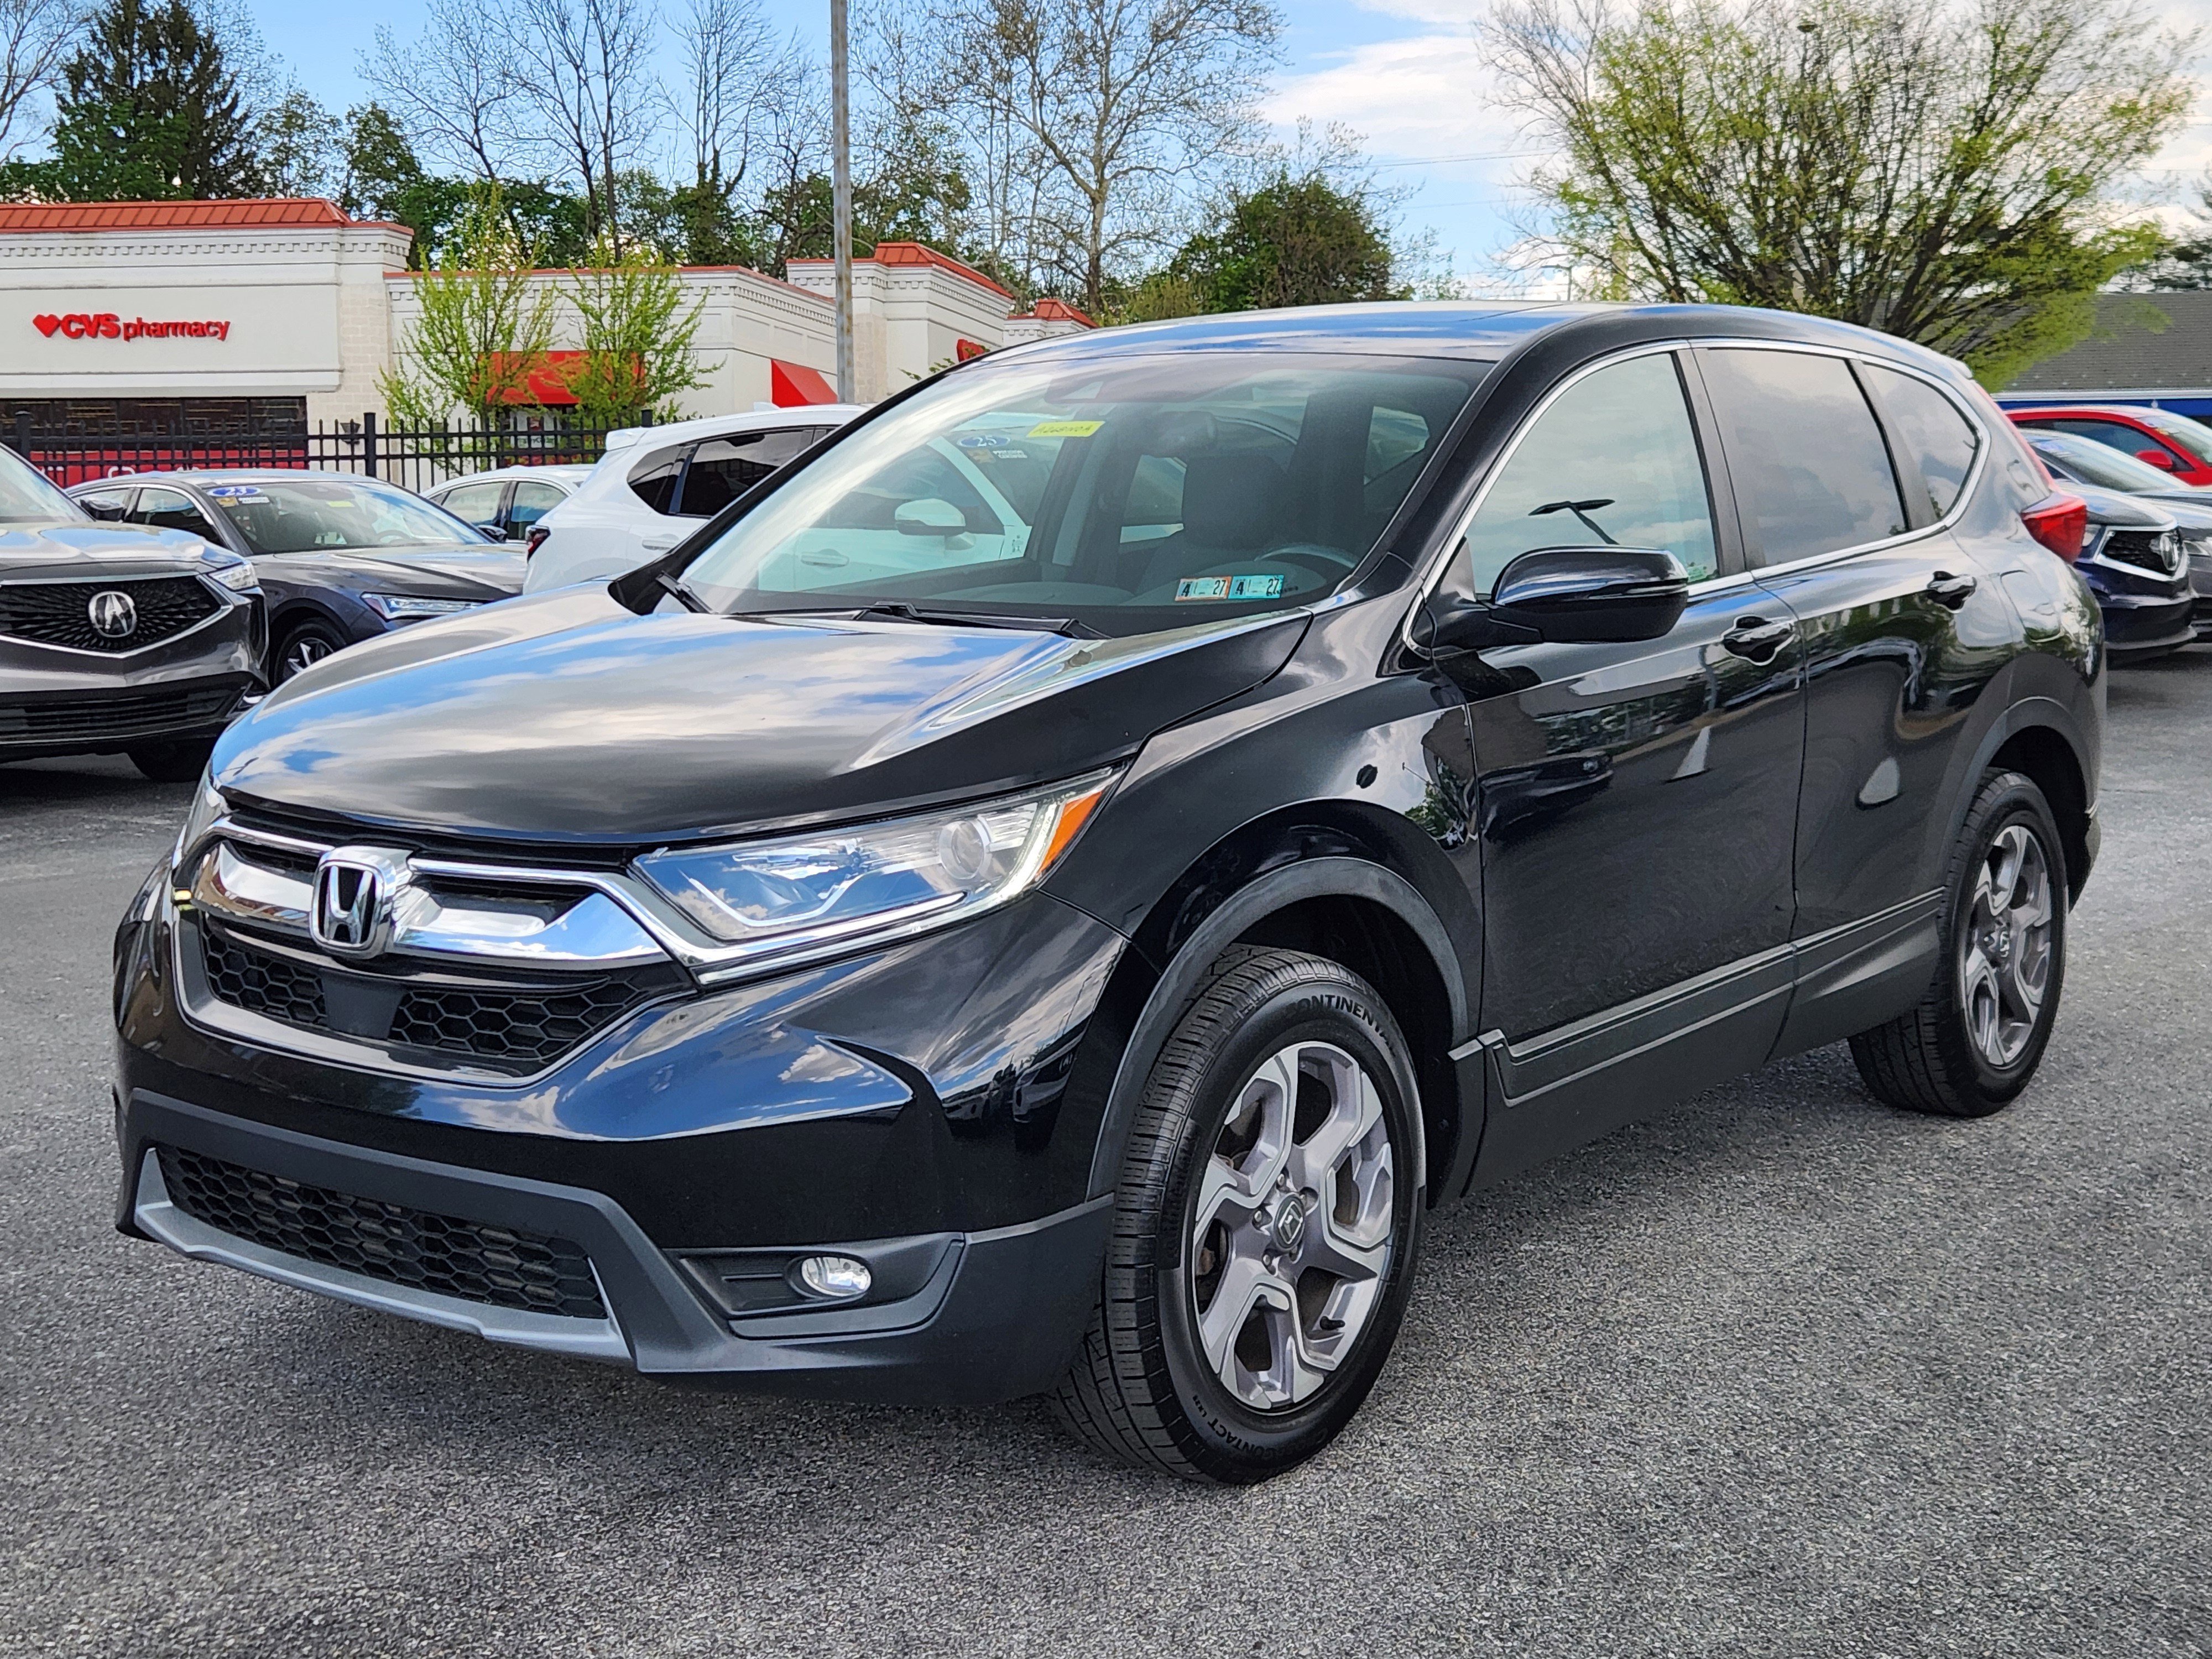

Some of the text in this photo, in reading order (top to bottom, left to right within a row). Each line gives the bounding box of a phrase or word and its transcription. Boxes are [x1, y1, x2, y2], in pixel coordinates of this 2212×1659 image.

[60, 313, 231, 342] CVS pharmacy
[973, 435, 997, 447] 25
[226, 486, 248, 496] 23
[1212, 580, 1227, 596] 27
[1266, 576, 1281, 597] 27
